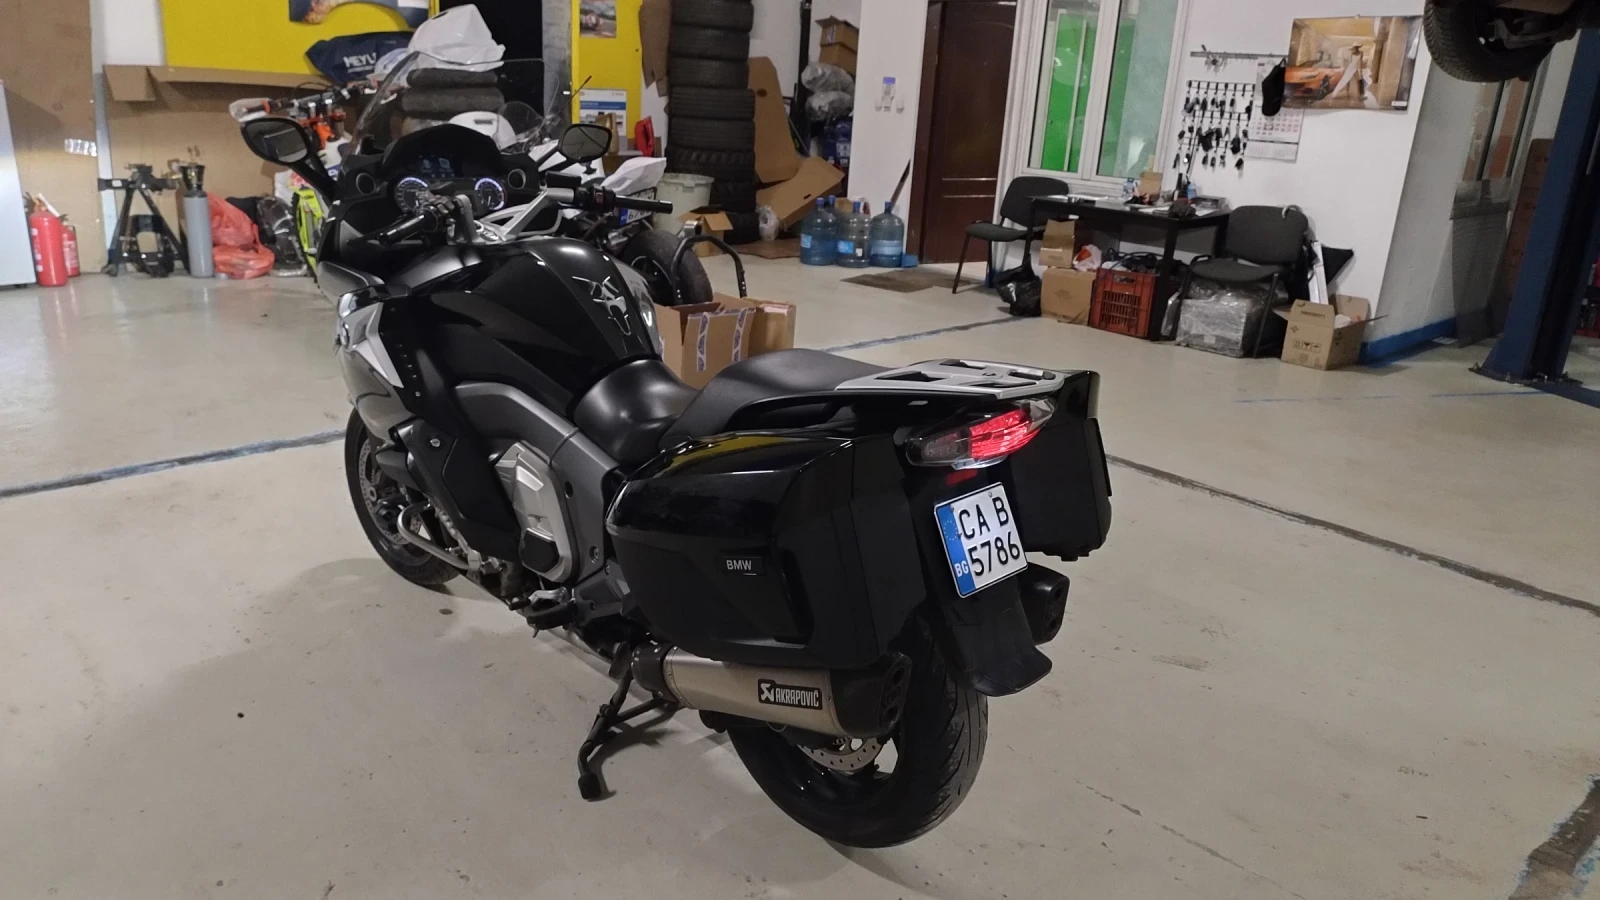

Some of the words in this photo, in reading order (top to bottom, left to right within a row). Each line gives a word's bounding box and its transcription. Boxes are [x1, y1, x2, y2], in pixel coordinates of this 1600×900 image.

[959, 504, 990, 539] CA
[991, 496, 1009, 527] B
[726, 559, 752, 570] BMW
[954, 560, 969, 577] BG
[968, 531, 1020, 576] 5786
